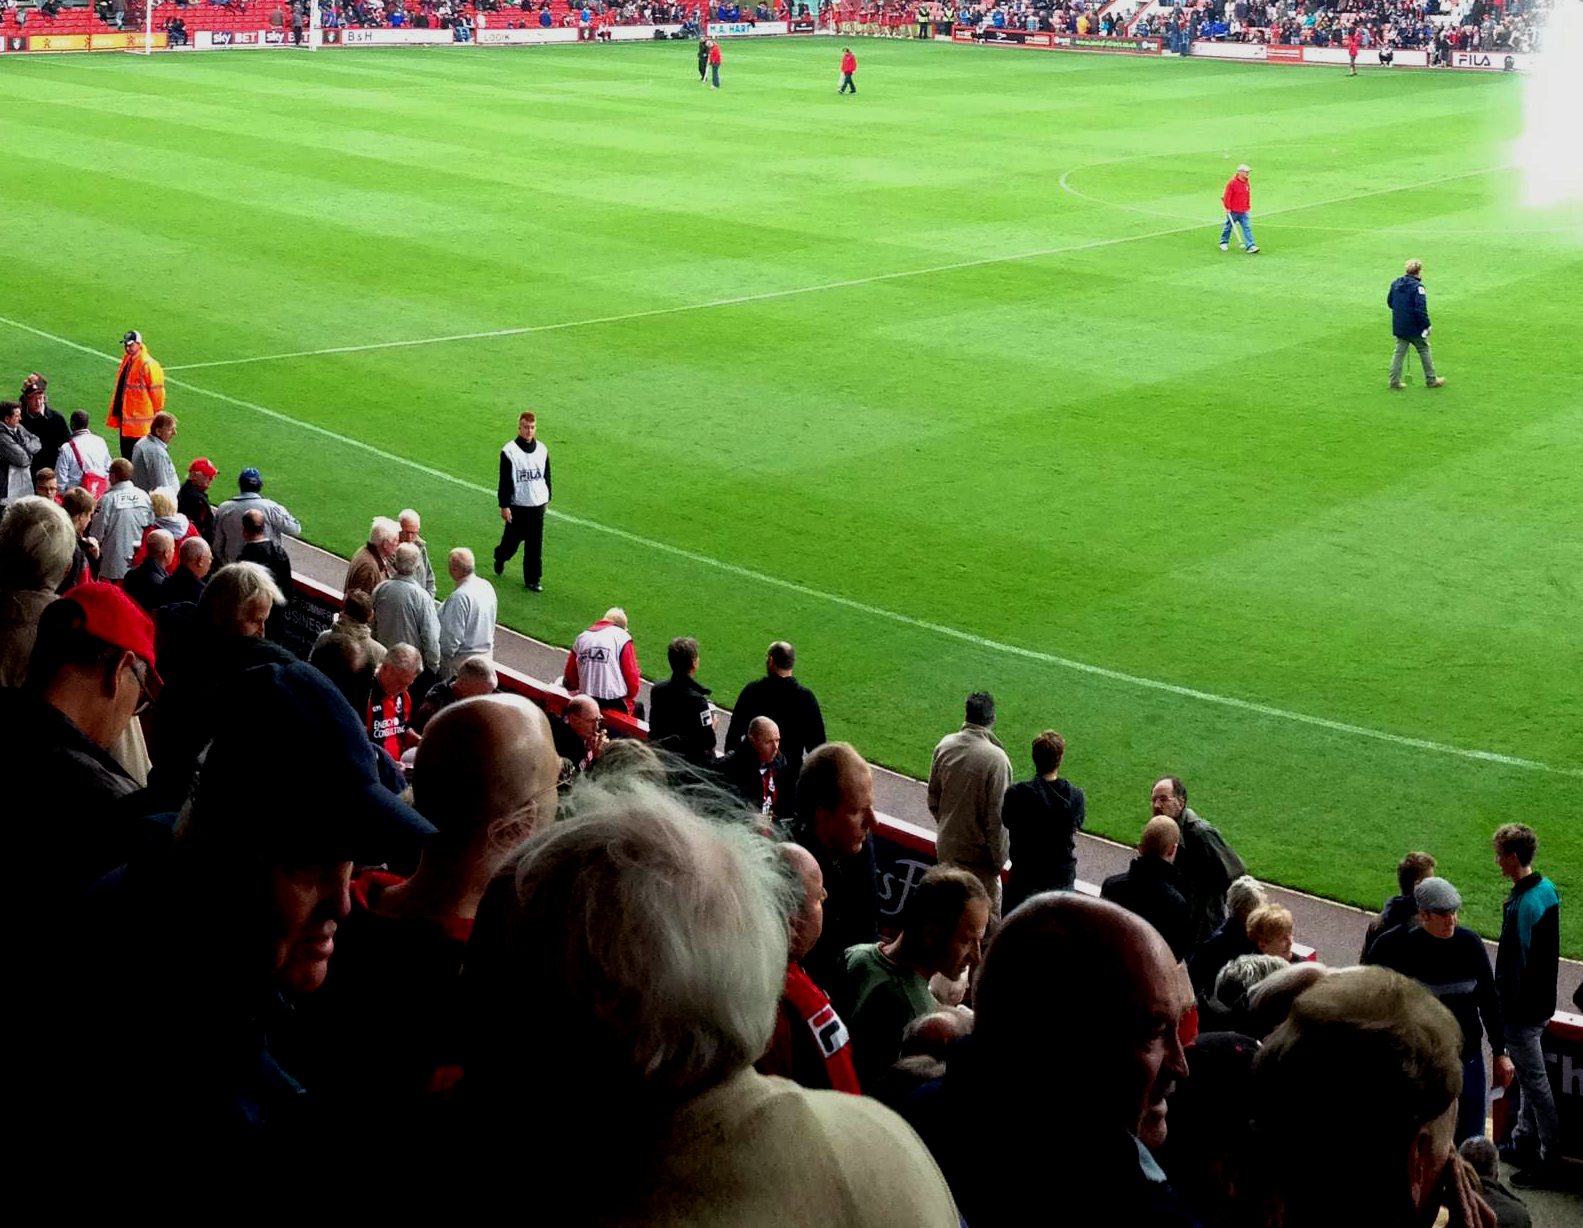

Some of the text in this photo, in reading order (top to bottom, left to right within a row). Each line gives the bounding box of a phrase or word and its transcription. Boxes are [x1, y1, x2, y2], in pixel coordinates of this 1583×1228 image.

[212, 32, 257, 45] sky BET
[265, 32, 284, 44] sky
[1458, 54, 1491, 66] FILA
